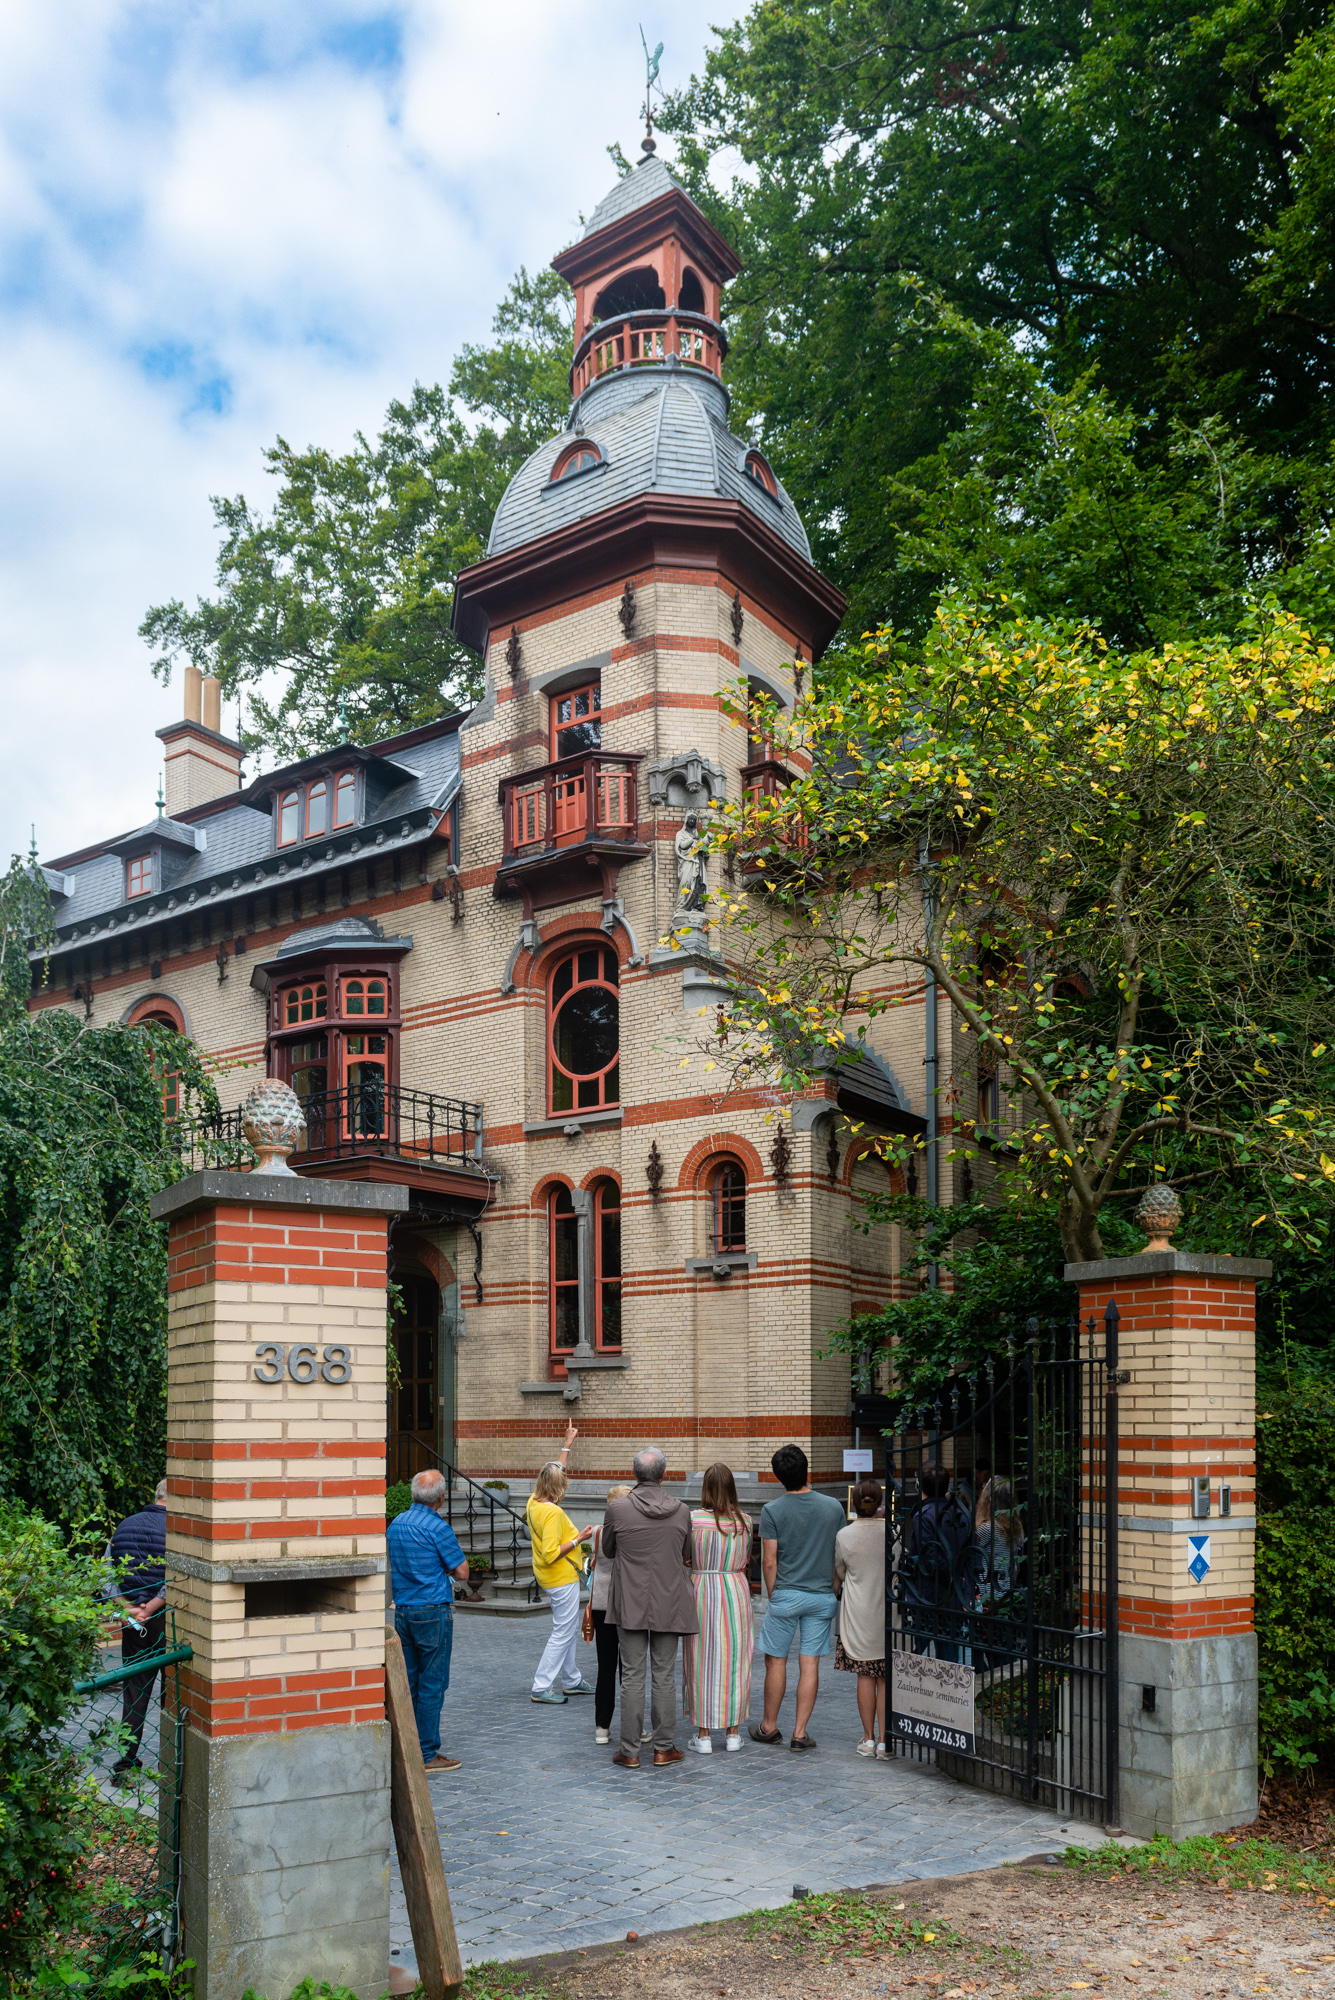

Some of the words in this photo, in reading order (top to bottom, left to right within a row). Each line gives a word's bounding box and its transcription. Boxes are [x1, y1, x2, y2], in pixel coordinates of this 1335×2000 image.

[254, 1342, 352, 1384] 368
[897, 1680, 934, 1698] Zaalverhuur
[936, 1692, 969, 1707] seminaries
[898, 1718, 912, 1733] +32
[914, 1722, 930, 1739] 496
[932, 1726, 967, 1749] 57.26.38
